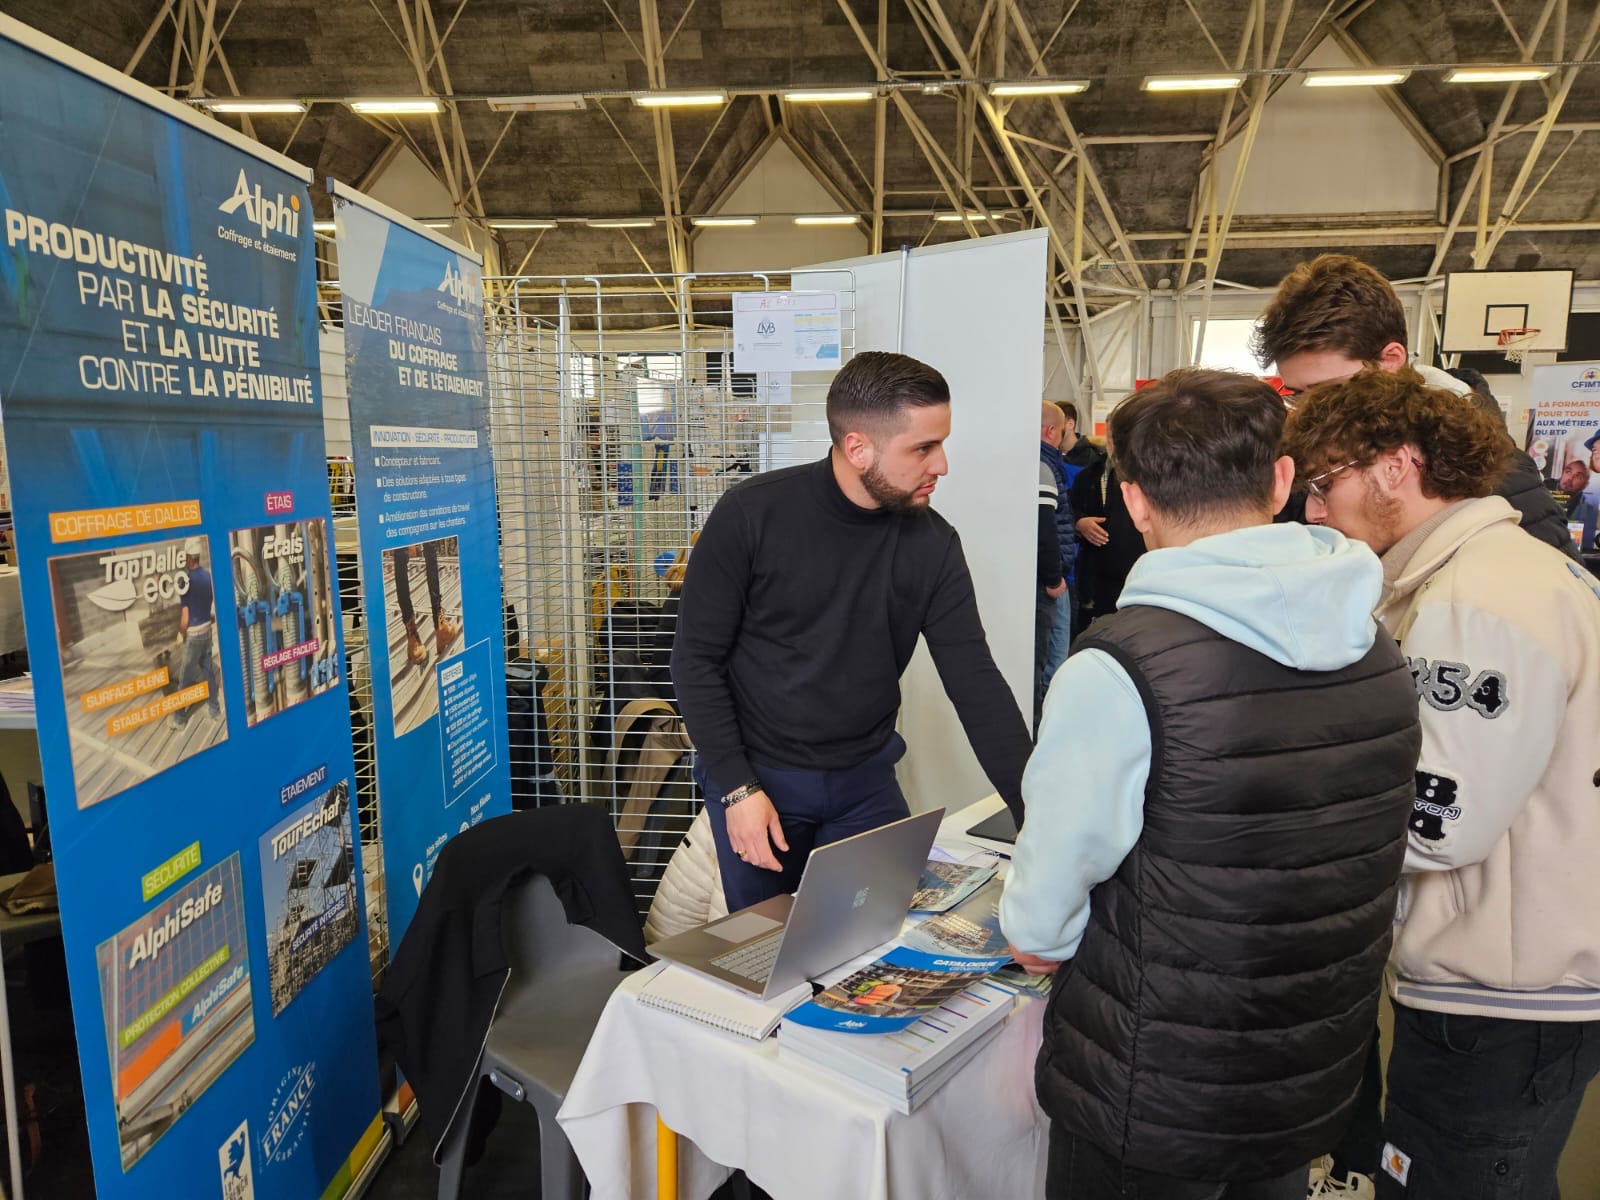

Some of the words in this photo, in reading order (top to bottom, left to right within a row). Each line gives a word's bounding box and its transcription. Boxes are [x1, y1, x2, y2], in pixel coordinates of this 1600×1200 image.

[218, 168, 300, 238] Alphi
[5, 208, 209, 291] PRODUCTIVITÉ
[218, 225, 252, 249] Coffrage
[254, 239, 262, 250] et
[263, 242, 297, 262] étaiement
[437, 260, 477, 309] Alphi
[77, 271, 134, 312] PAR
[140, 284, 176, 321] LA
[182, 290, 280, 339] SÉCURITÉ
[347, 302, 393, 334] LEADER
[395, 315, 442, 346] FRANÇAIS
[121, 320, 149, 354] ET
[157, 326, 192, 359] LA
[198, 332, 260, 368] LUTTE
[389, 339, 406, 361] DU
[409, 344, 459, 371] COFFRAGE
[79, 355, 182, 395] CONTRE
[188, 366, 219, 397] LA
[223, 366, 314, 404] PÉNIBILITÉ
[398, 366, 412, 386] ET
[414, 369, 429, 389] DE
[431, 368, 484, 397] L'ÉTAIEMENT
[1552, 400, 1600, 408] FORMATIO
[1558, 418, 1599, 427] MÉTIERS
[381, 455, 412, 468] Concepteur
[382, 476, 394, 487] Des
[395, 475, 418, 487] solutions
[384, 492, 391, 503] de
[55, 512, 133, 536] COFFRAGE
[136, 509, 152, 527] DE
[154, 504, 199, 524] DALLES
[266, 494, 292, 511] ÉTAIS
[385, 510, 418, 523] Amélioration
[263, 532, 304, 559] Etais
[386, 527, 398, 538] des
[143, 570, 190, 603] eco
[263, 650, 293, 669] RÉGLAGE
[86, 682, 134, 709] SURFACE
[136, 671, 166, 692] PLEINE
[112, 708, 150, 733] STABLE
[150, 703, 161, 717] ET
[162, 684, 205, 711] SÉCURISÉE
[281, 766, 326, 804] ÉTAIEMENT
[271, 795, 341, 861] TourEchaf
[145, 844, 199, 894] SÉCURITÉ
[129, 883, 223, 969] AlphiSafe
[292, 919, 319, 951] SÉCURITÉ
[933, 959, 999, 968] CATALOGUE
[124, 988, 180, 1042] PROTECTION
[180, 950, 226, 996] COLLECTIVE
[191, 965, 244, 1024] AlphiSafe
[263, 1068, 314, 1159] FRANCE
